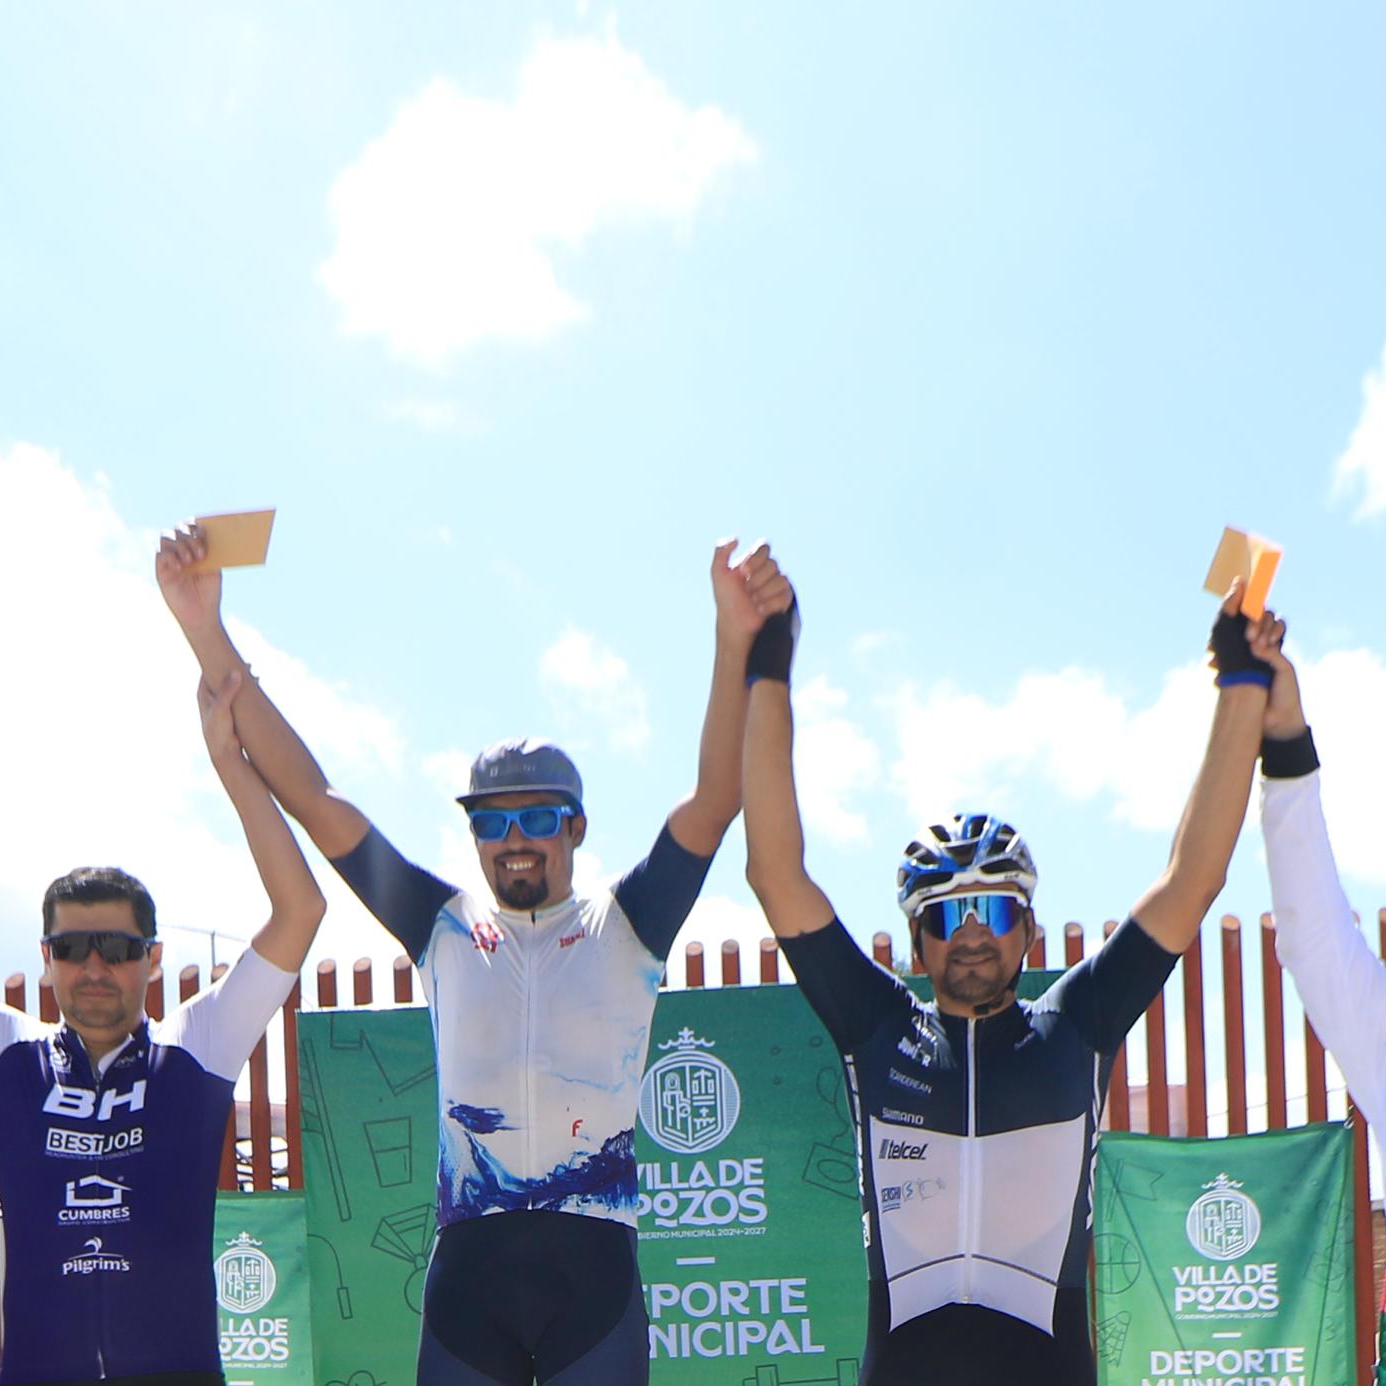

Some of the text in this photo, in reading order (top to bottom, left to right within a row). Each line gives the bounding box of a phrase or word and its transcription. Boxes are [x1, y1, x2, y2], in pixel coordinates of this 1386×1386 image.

[42, 1079, 147, 1121] BH
[718, 1158, 764, 1187] DE
[58, 1206, 130, 1221] CUMBRES
[638, 1230, 670, 1240] BIERNO
[671, 1229, 716, 1239] MUNICIPAL
[1173, 1263, 1278, 1286] VILLA DE
[259, 1318, 289, 1336] DE
[649, 1318, 826, 1359] NICIPAL
[1150, 1347, 1305, 1376] DEPORTE
